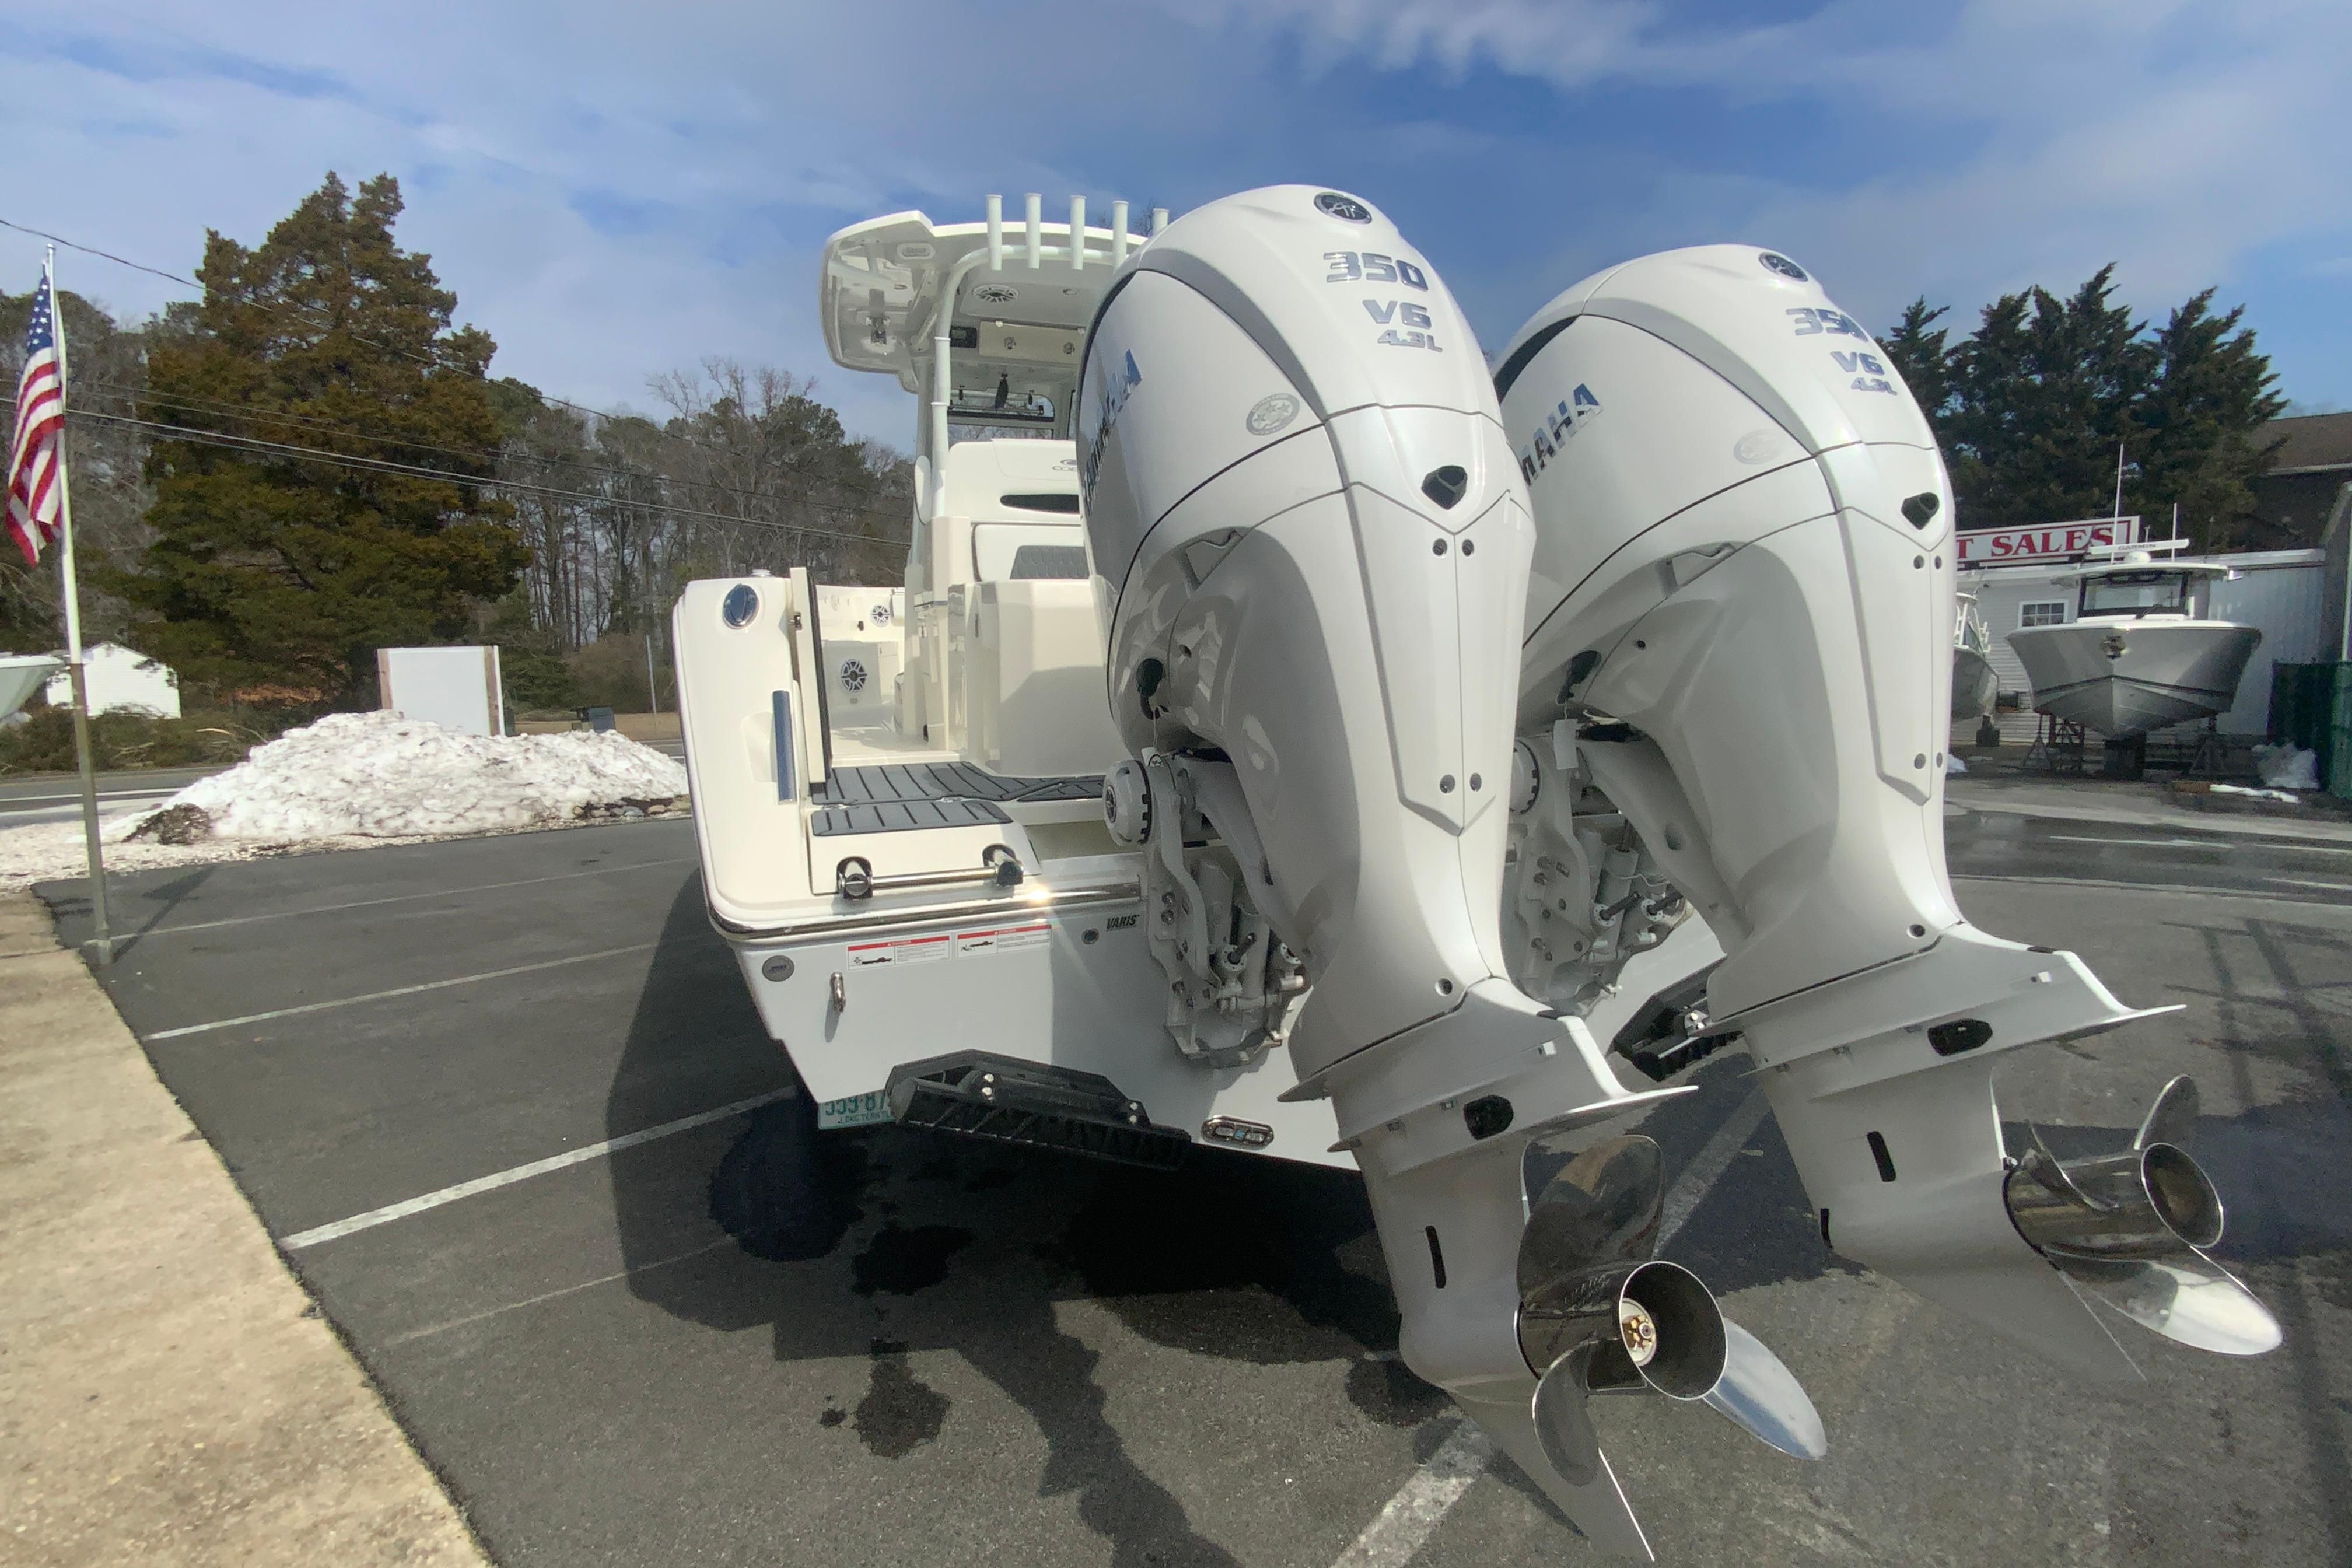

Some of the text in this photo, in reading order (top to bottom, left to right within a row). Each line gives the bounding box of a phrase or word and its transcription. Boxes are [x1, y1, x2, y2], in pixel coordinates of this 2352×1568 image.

[1324, 251, 1429, 292] 350
[1362, 299, 1432, 330] V6
[1830, 351, 1885, 376] V6
[1990, 526, 2113, 558] SALES
[1107, 915, 1138, 929] VARIS
